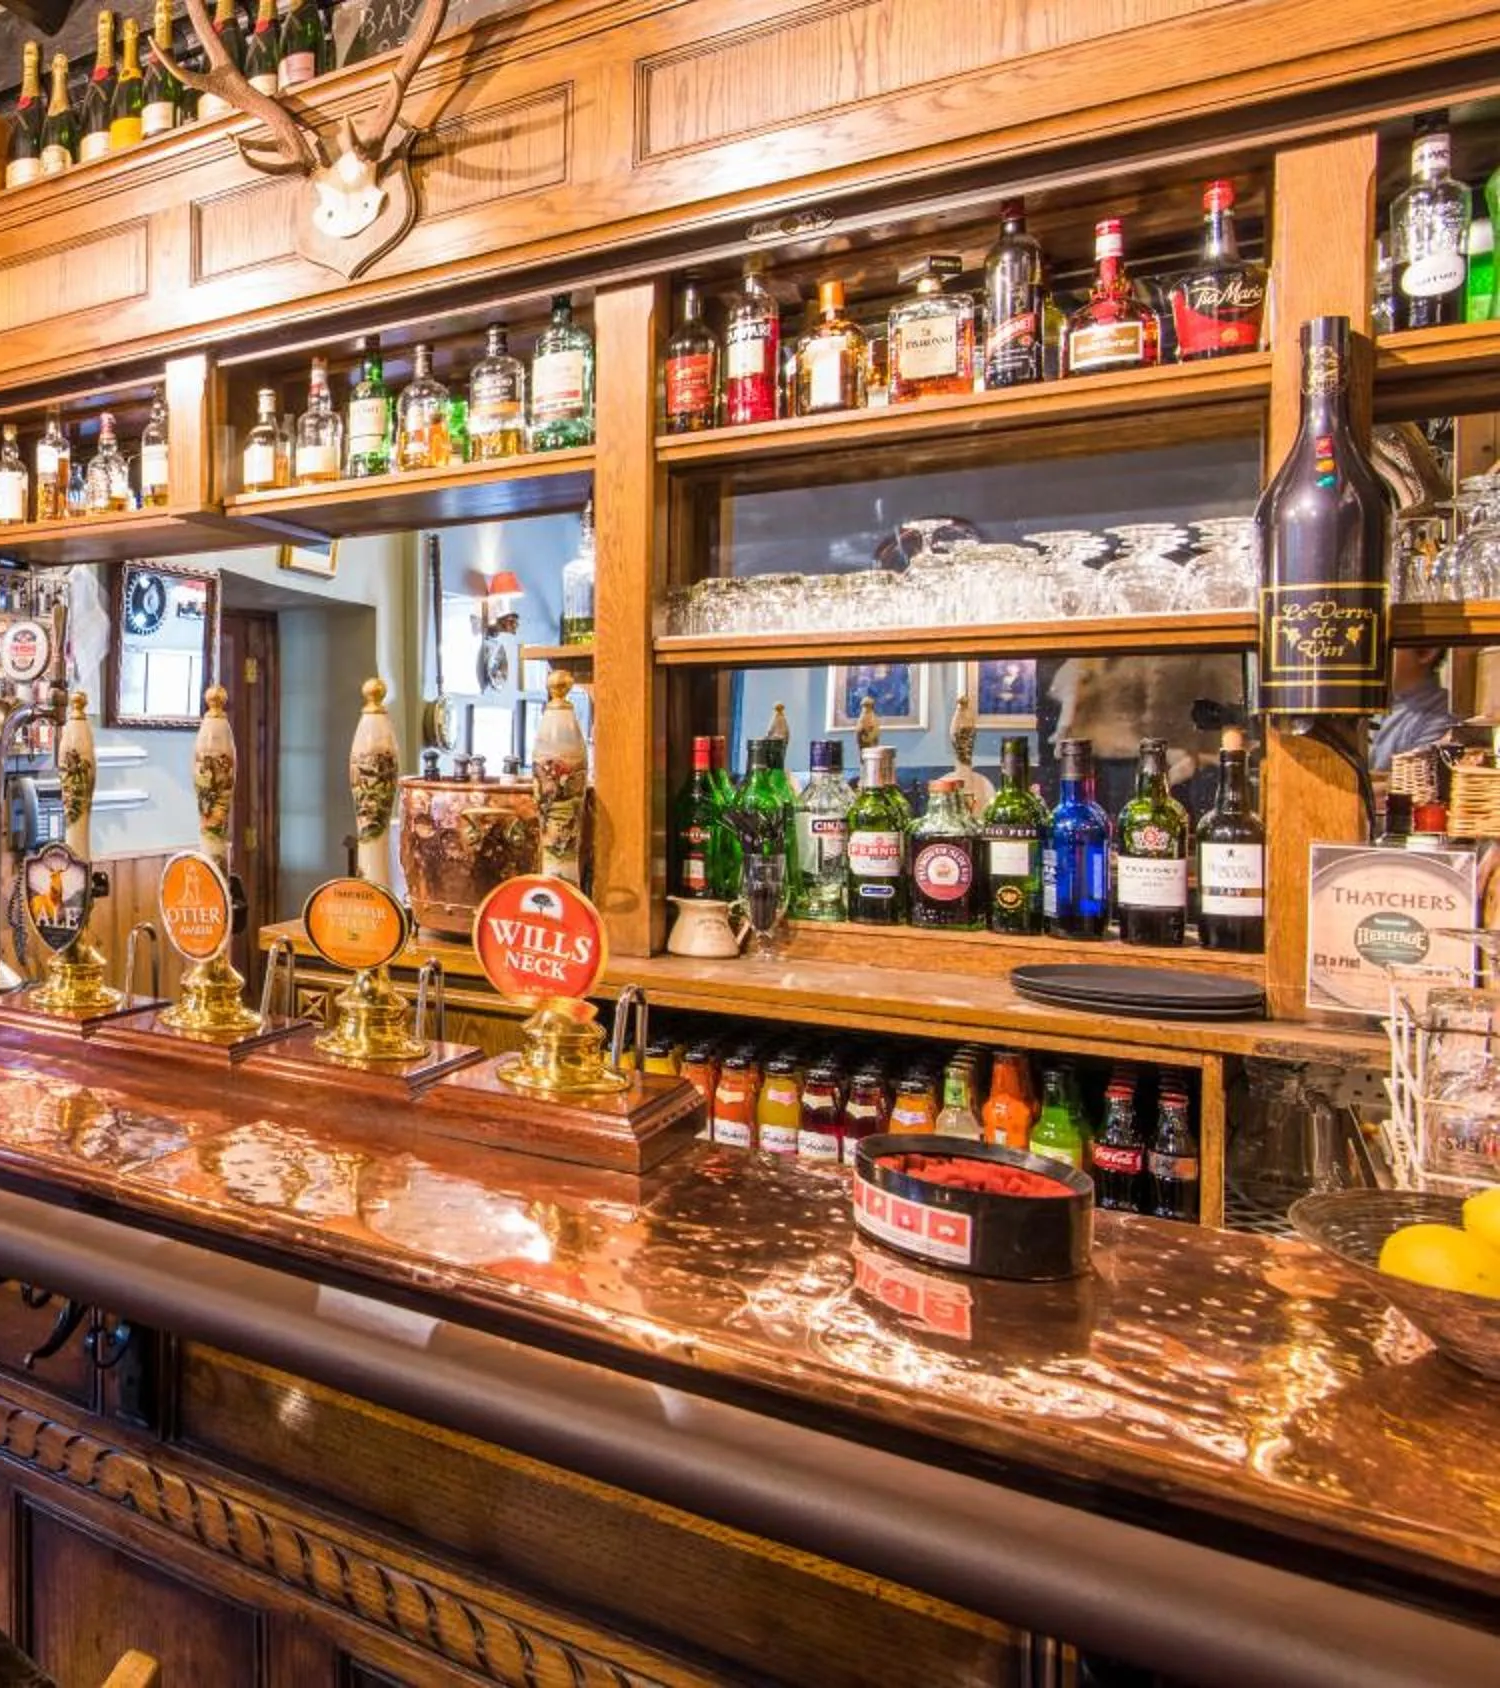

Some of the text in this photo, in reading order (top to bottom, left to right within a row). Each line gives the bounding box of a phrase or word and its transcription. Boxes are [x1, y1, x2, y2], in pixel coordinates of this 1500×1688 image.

[1281, 600, 1373, 621] Le Verre
[1312, 621, 1337, 639] de
[1297, 638, 1345, 658] Vin
[1332, 886, 1457, 912] THATCHERS
[35, 904, 83, 930] ALE
[165, 905, 223, 925] OTTER
[486, 917, 594, 965] WILLS
[504, 948, 566, 982] NECK
